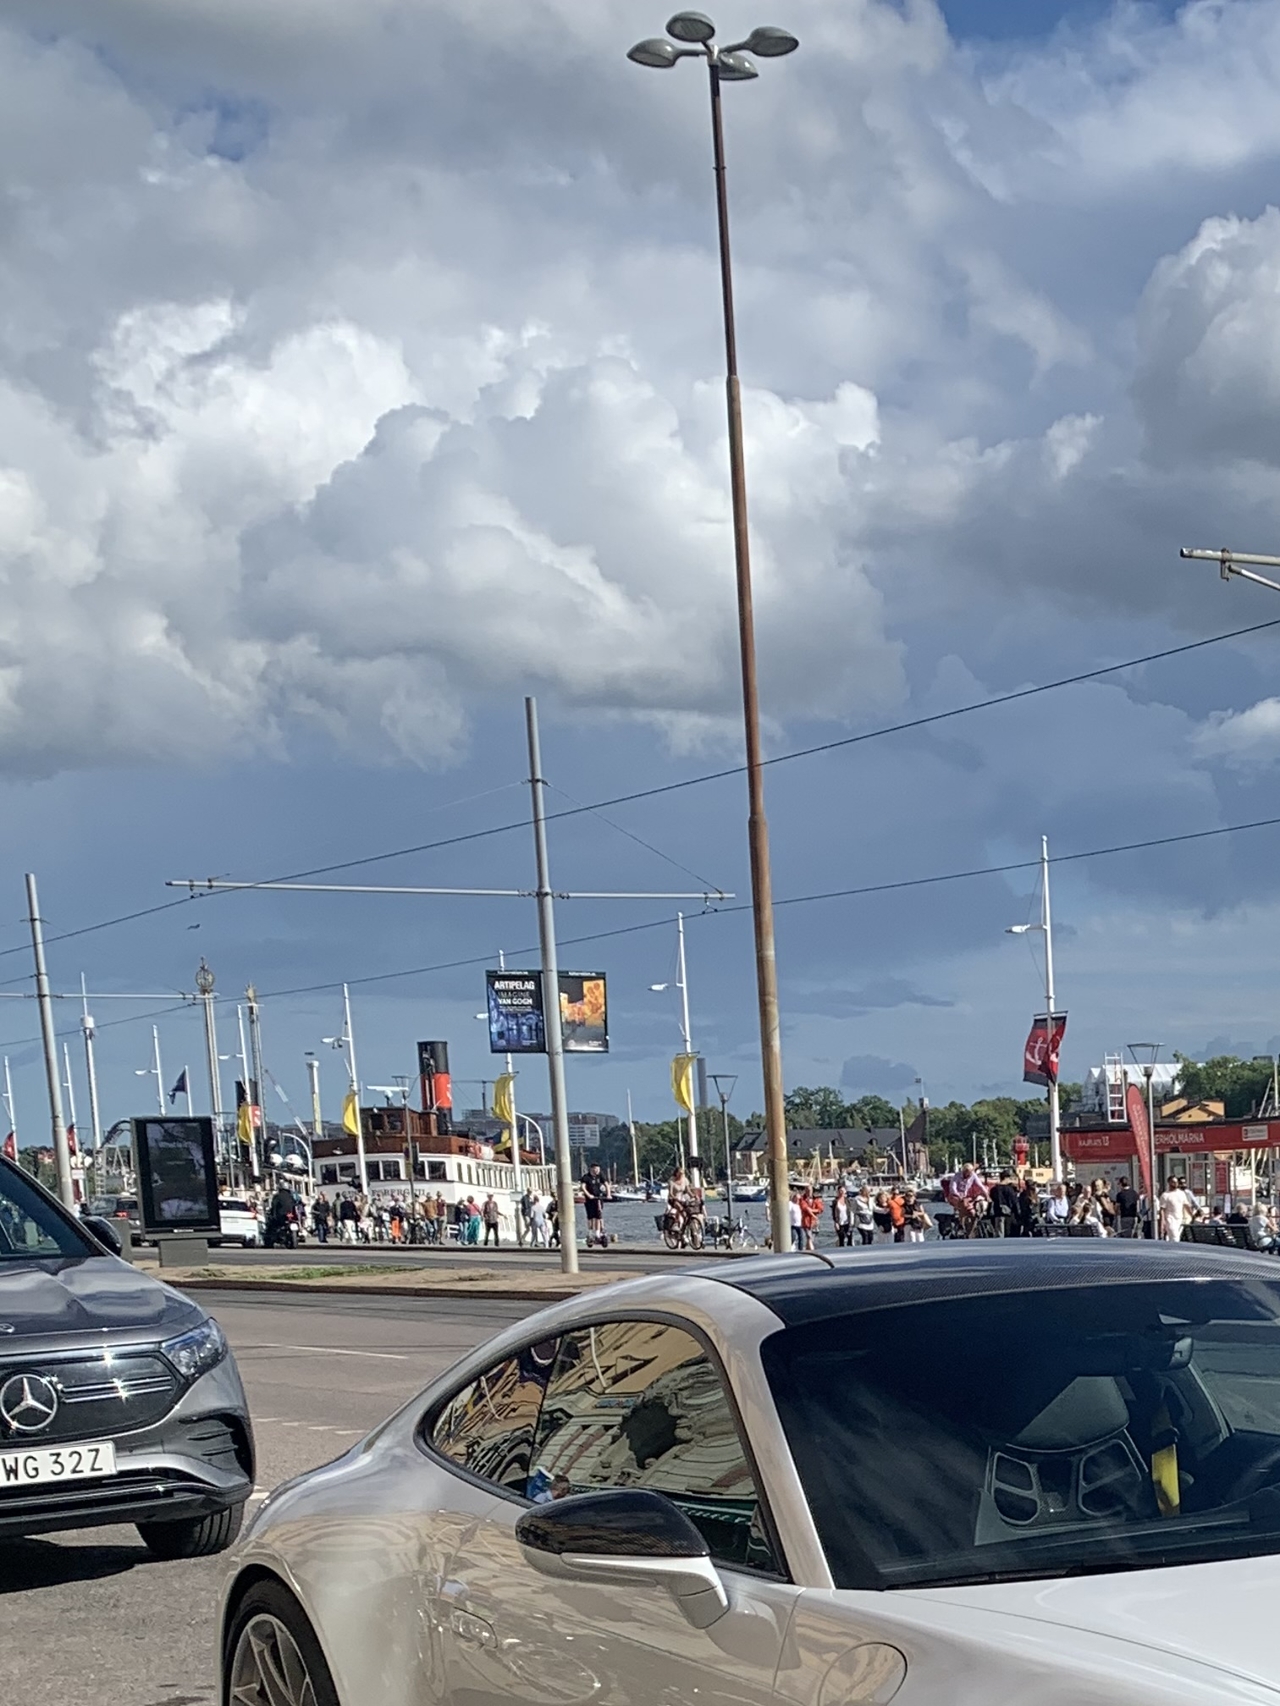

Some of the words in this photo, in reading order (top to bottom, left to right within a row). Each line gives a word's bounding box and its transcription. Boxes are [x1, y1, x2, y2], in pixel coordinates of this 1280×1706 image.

[494, 980, 535, 990] ARTIPELAG
[1102, 1135, 1110, 1147] 13
[1155, 1132, 1205, 1145] ERHOLMARNA
[1, 1456, 39, 1482] WG
[50, 1448, 103, 1476] 32Z
